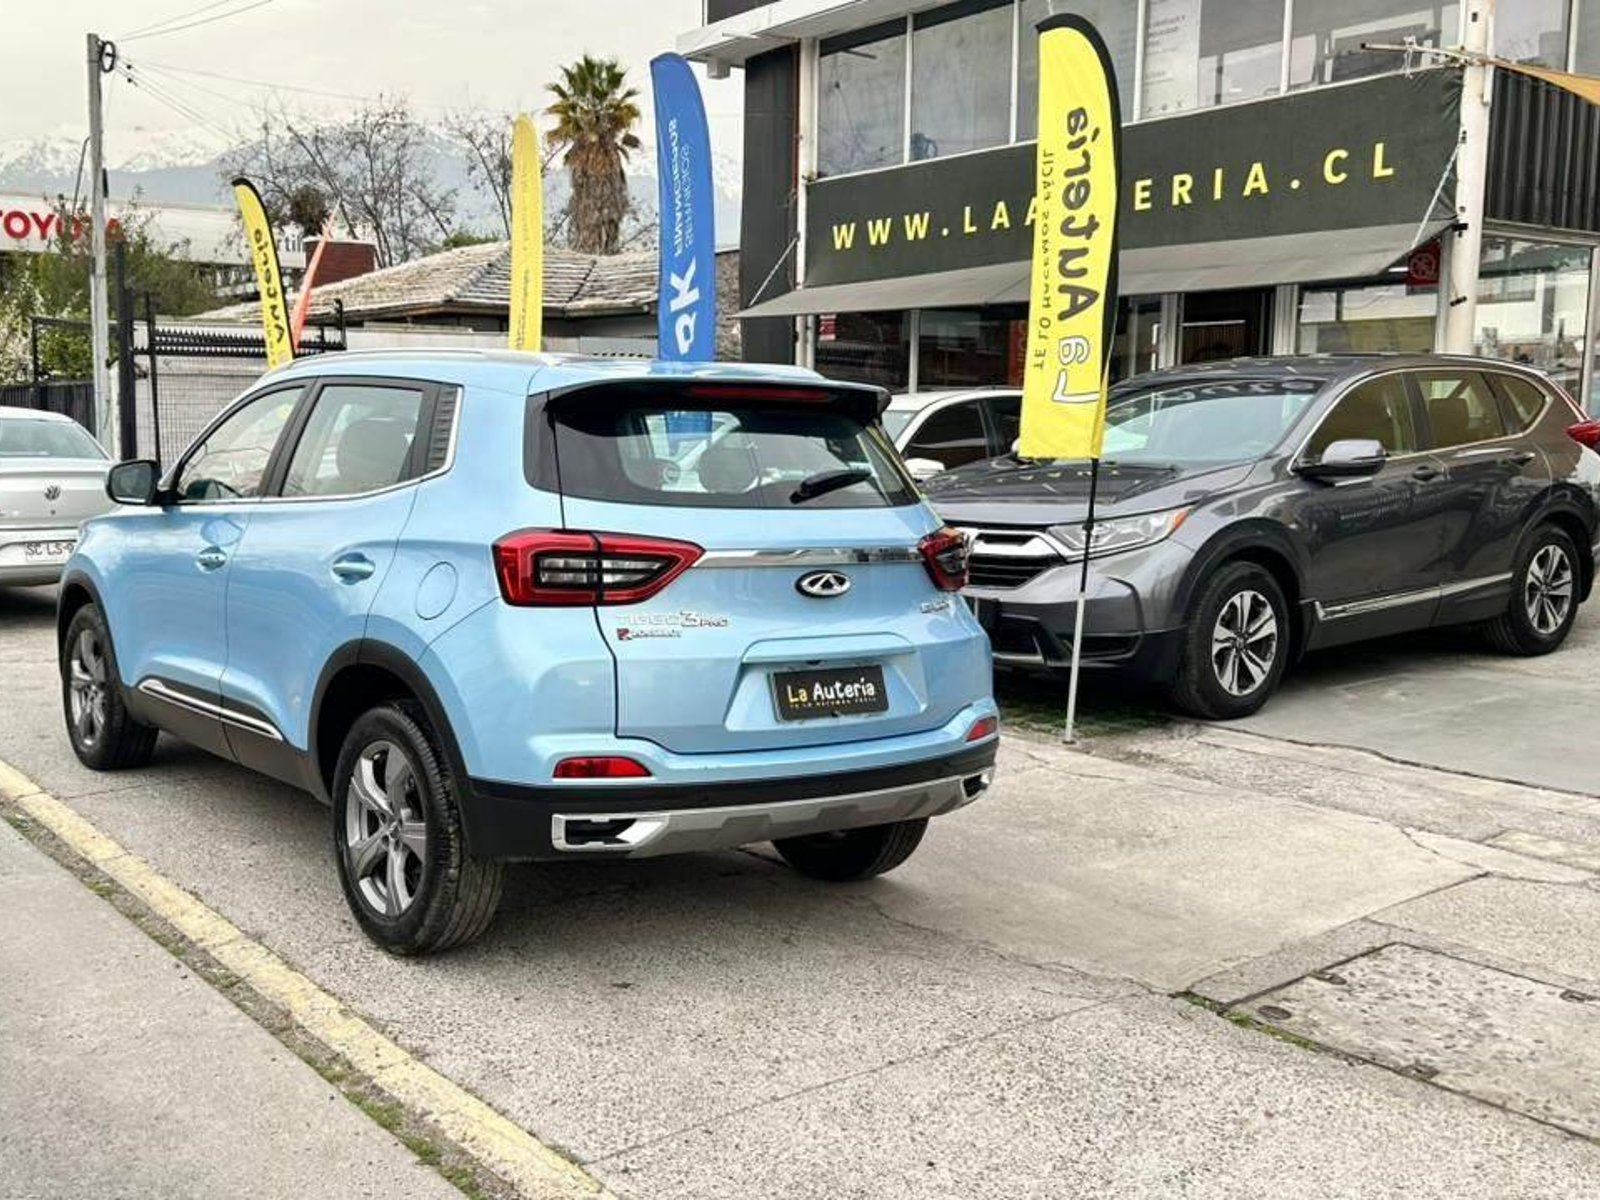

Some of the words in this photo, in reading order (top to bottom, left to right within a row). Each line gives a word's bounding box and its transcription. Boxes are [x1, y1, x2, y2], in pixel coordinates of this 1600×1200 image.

[832, 141, 1395, 251] WWW.LAAERIA.CL
[787, 684, 808, 703] La
[813, 676, 876, 701] Autería
